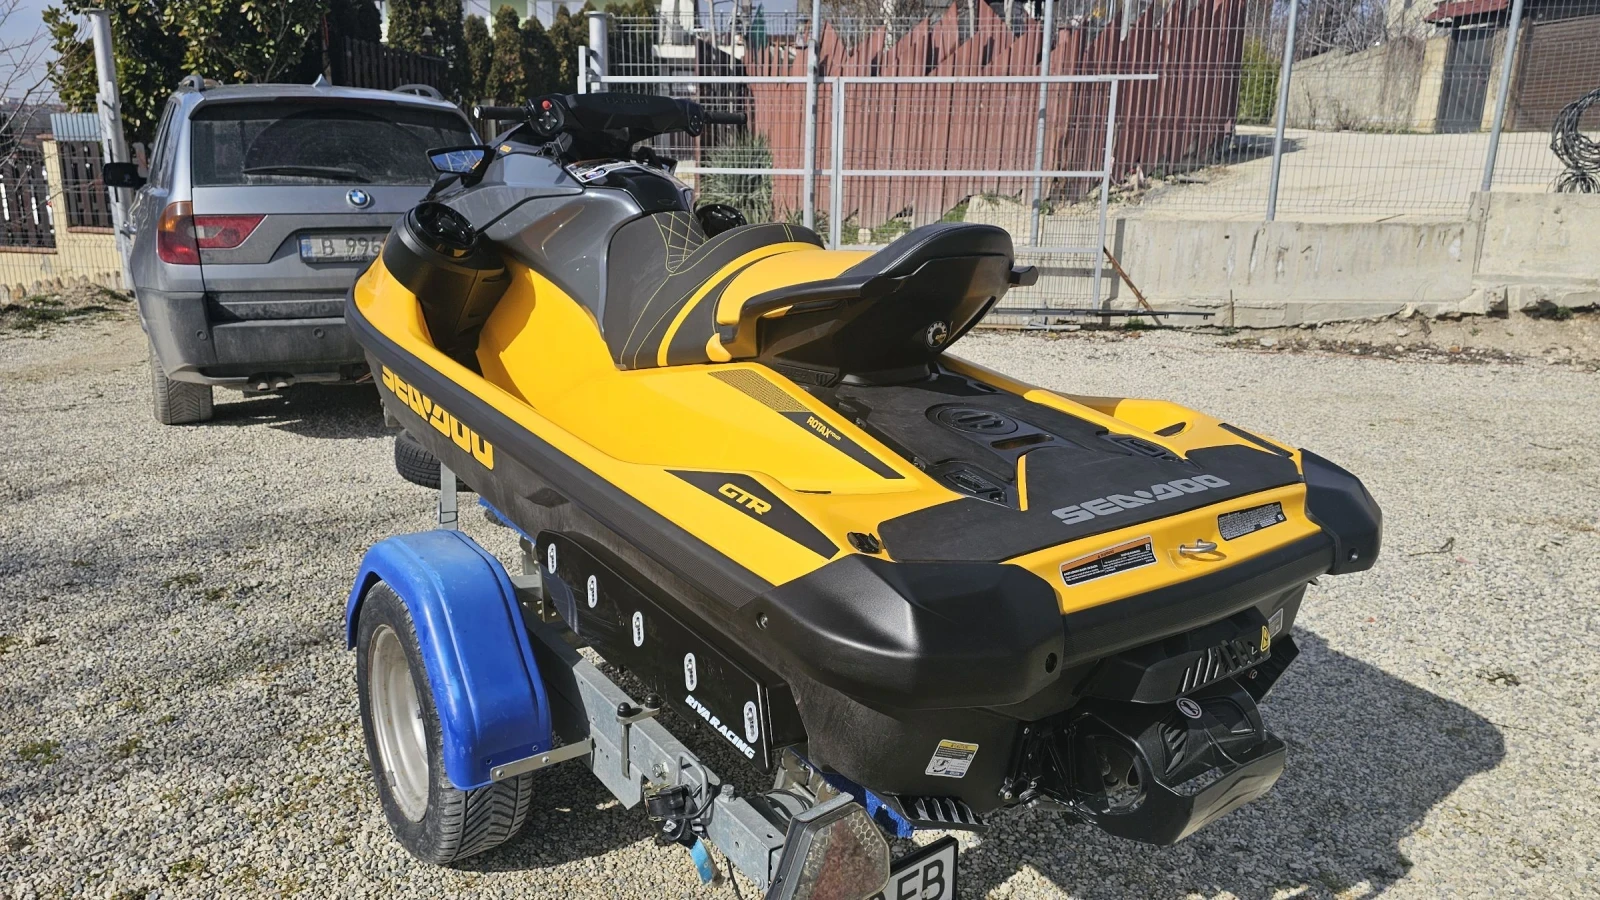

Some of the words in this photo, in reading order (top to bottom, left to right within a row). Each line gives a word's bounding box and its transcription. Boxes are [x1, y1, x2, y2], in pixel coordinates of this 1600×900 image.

[322, 239, 335, 256] B
[345, 237, 386, 255] 996
[806, 415, 831, 439] ROTAX
[718, 483, 772, 515] GTR
[685, 694, 711, 722] RIVA
[709, 716, 756, 759] RACING
